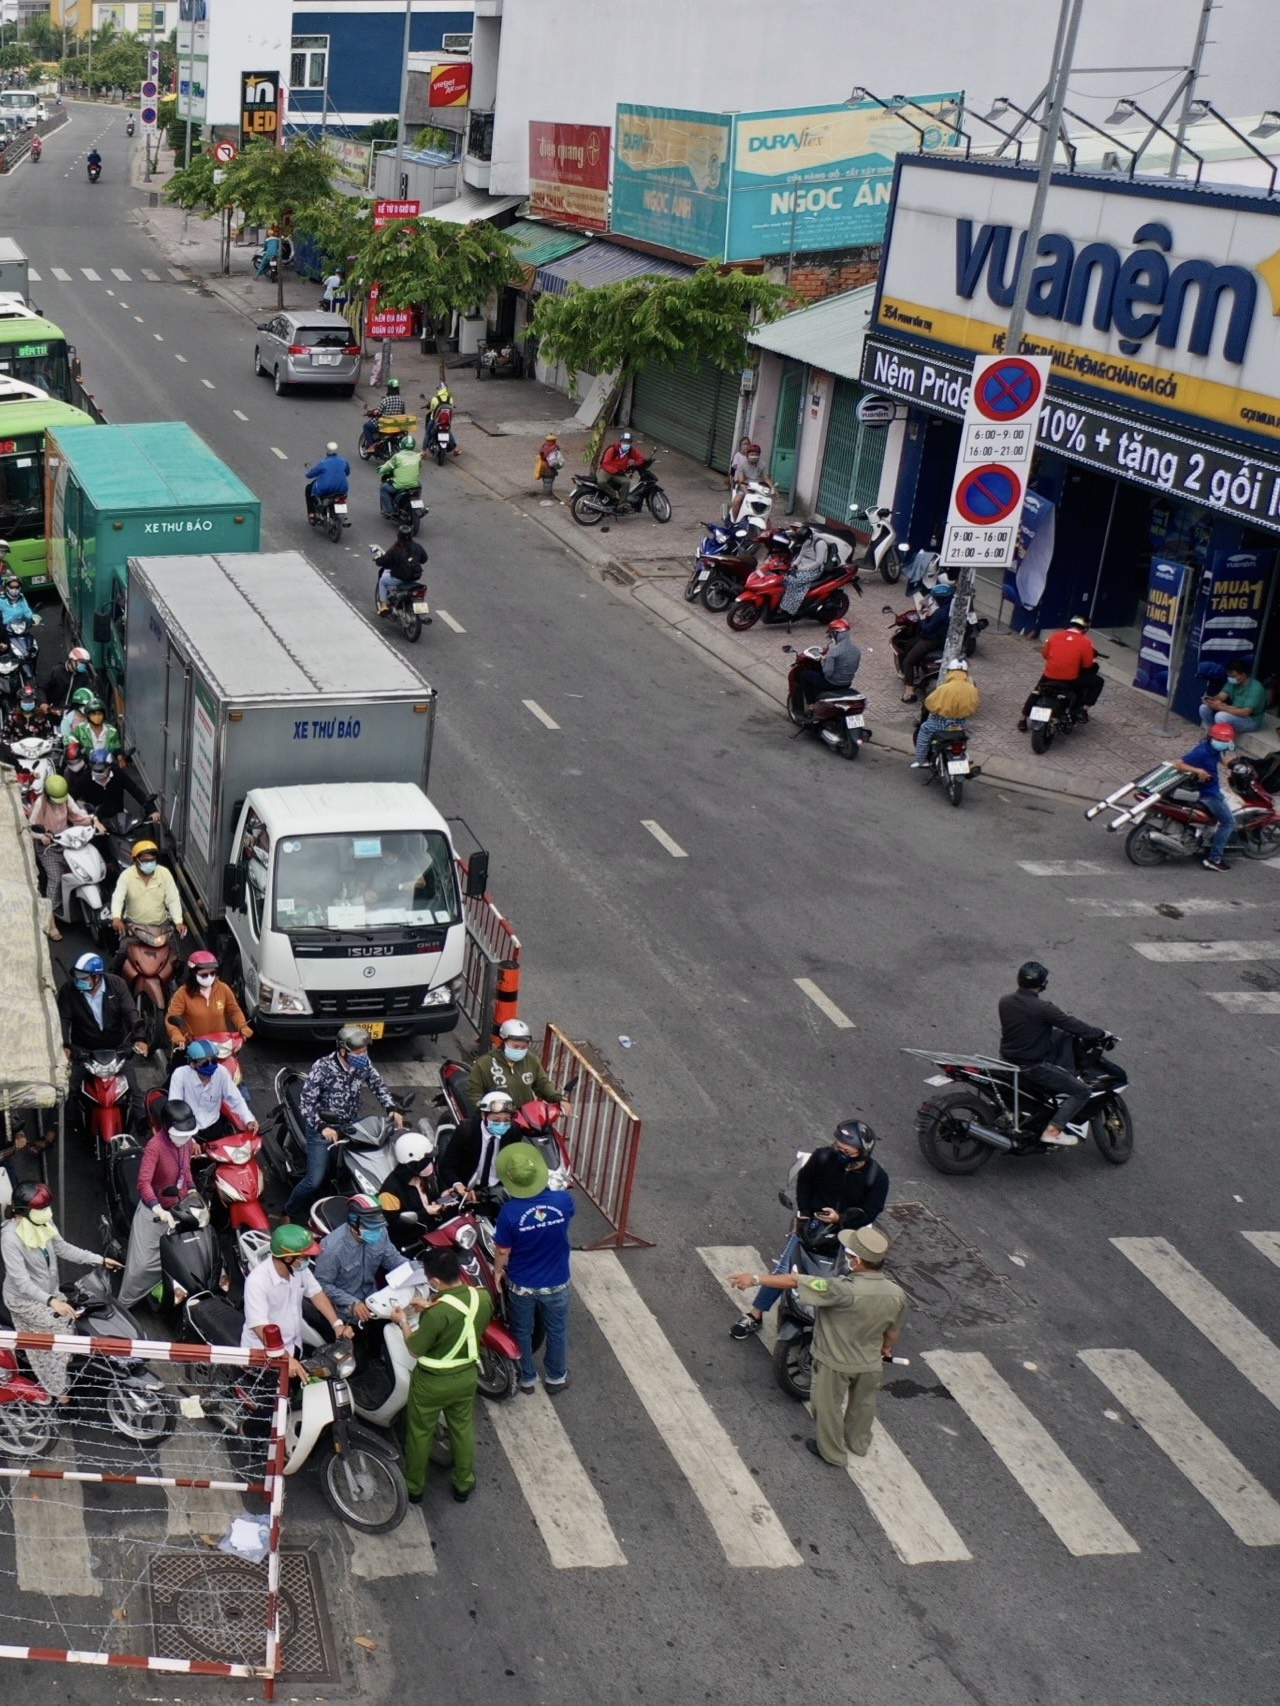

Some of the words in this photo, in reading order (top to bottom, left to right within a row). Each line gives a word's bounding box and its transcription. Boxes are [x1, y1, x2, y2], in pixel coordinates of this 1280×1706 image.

[242, 111, 277, 133] LED
[557, 145, 584, 172] quang
[770, 186, 844, 217] NGỌC
[992, 331, 1006, 354] HỆ
[1061, 348, 1073, 370] LẺ
[1137, 373, 1154, 393] GA
[1154, 372, 1179, 399] GỐI
[874, 350, 916, 394] Nệm
[920, 365, 971, 411] Pride
[1039, 404, 1087, 452] 10%
[1094, 427, 1111, 453] +
[1117, 431, 1179, 490] tặng
[1184, 454, 1206, 492] 2
[1208, 456, 1264, 508] gối
[144, 523, 159, 533] XE
[161, 521, 184, 533] THƯ
[186, 519, 213, 532] BÁO
[953, 532, 974, 542] 9:00
[983, 532, 1008, 542] 16:00
[951, 547, 976, 558] 21:00
[984, 547, 1005, 558] 6:00
[1150, 588, 1169, 607] MUA
[1211, 595, 1249, 613] TẶNG
[1213, 580, 1250, 595] MUA
[1250, 580, 1264, 610] 1
[293, 722, 308, 740] XE
[312, 716, 336, 739] THƯ
[337, 715, 361, 739] BÁO
[348, 946, 394, 957] ISUZU
